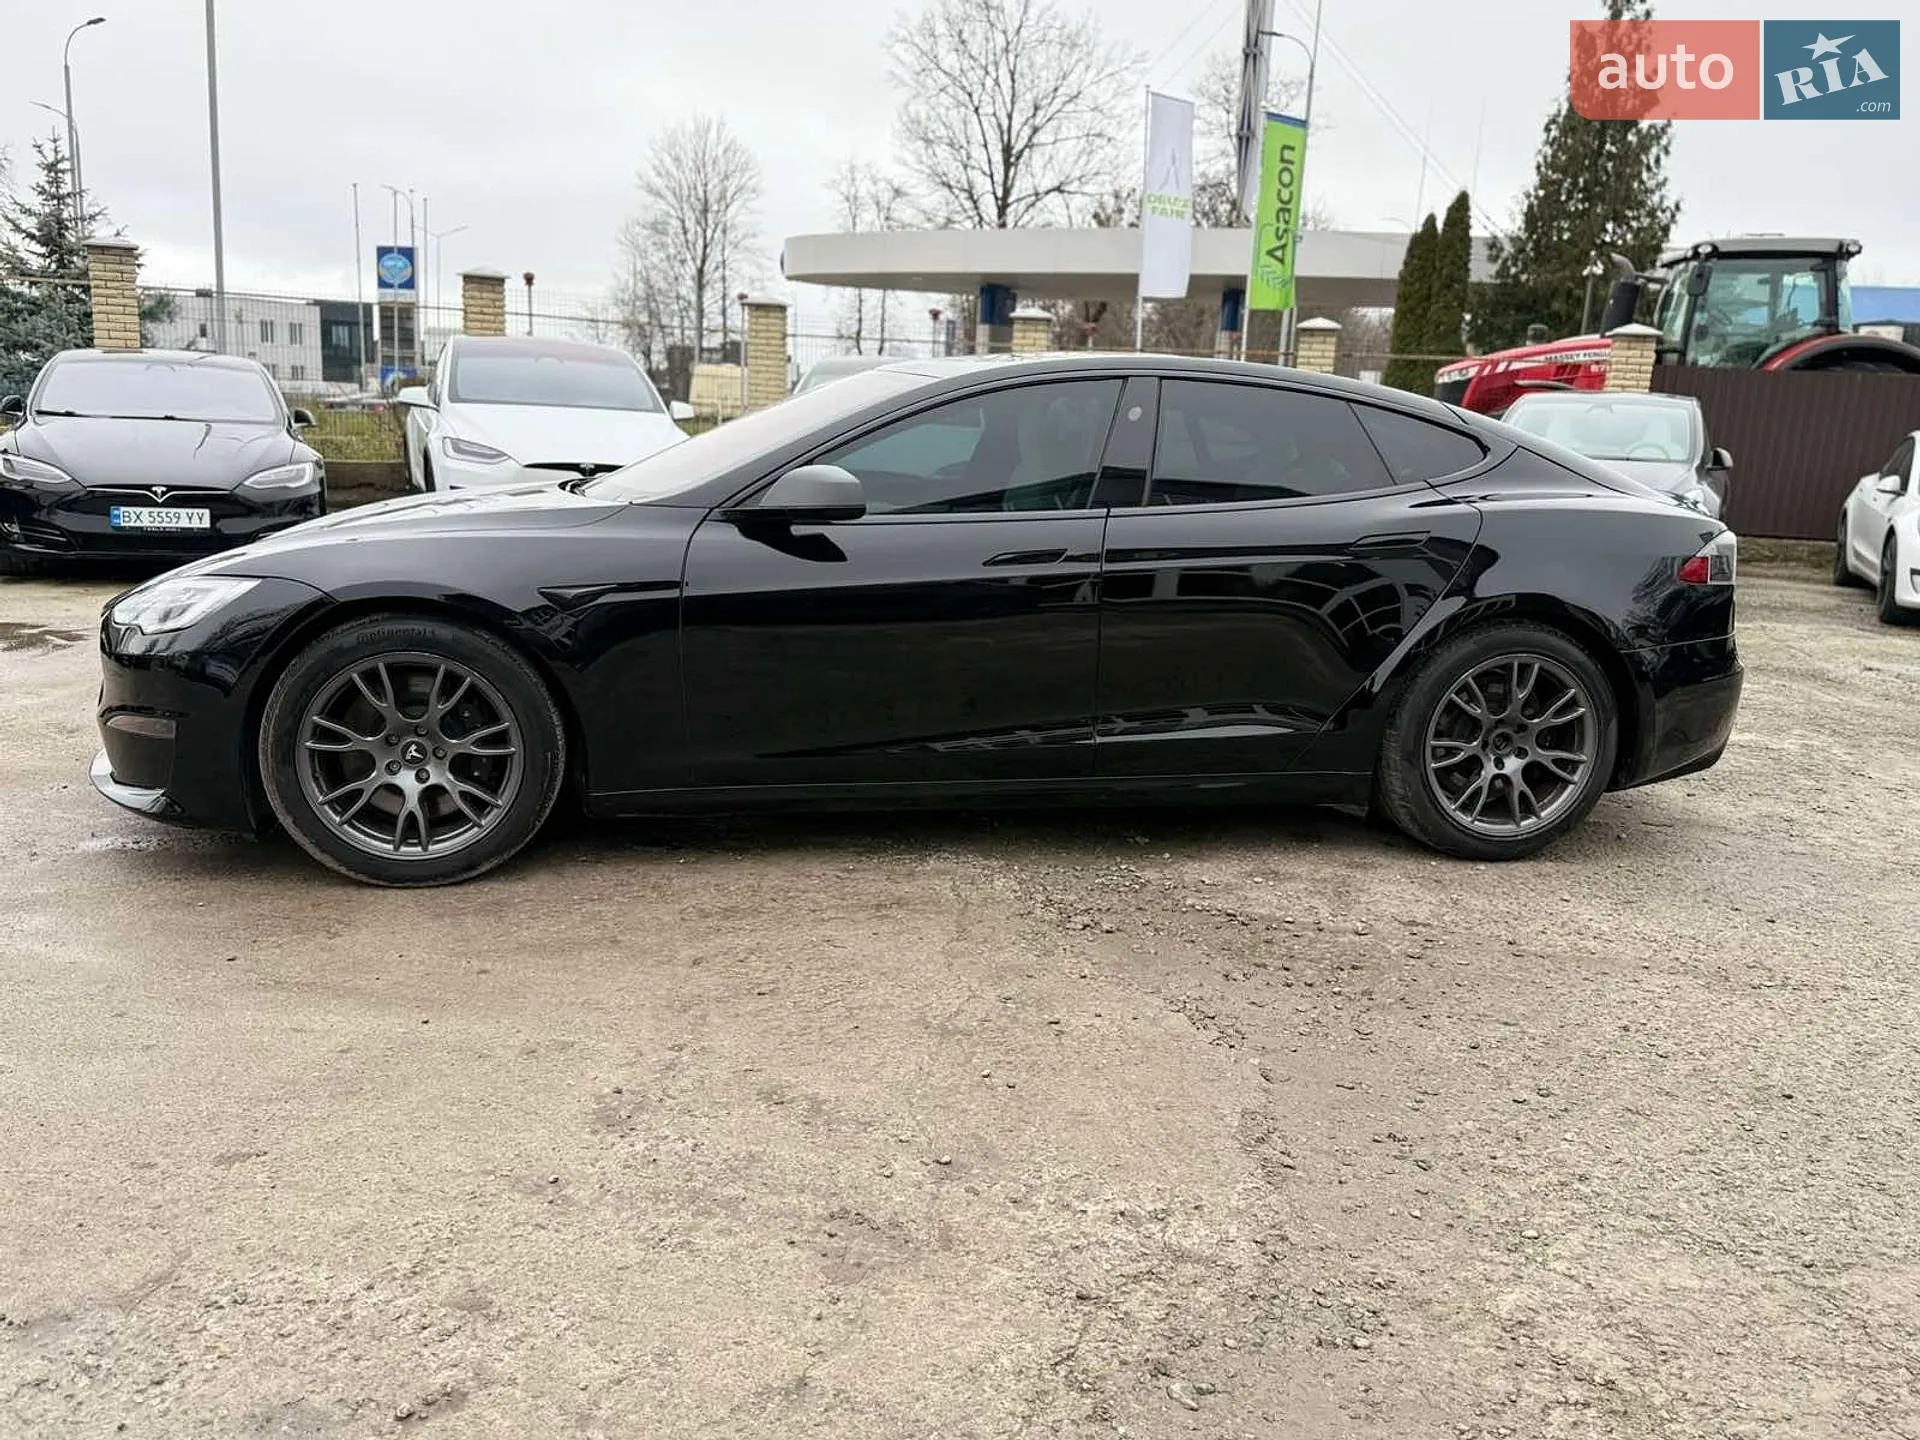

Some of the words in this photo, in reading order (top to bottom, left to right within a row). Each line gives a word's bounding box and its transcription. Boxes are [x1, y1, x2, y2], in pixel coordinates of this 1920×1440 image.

[1265, 144, 1296, 265] Asacon
[122, 510, 144, 524] BX
[148, 511, 181, 525] 5559
[186, 512, 204, 525] YY
